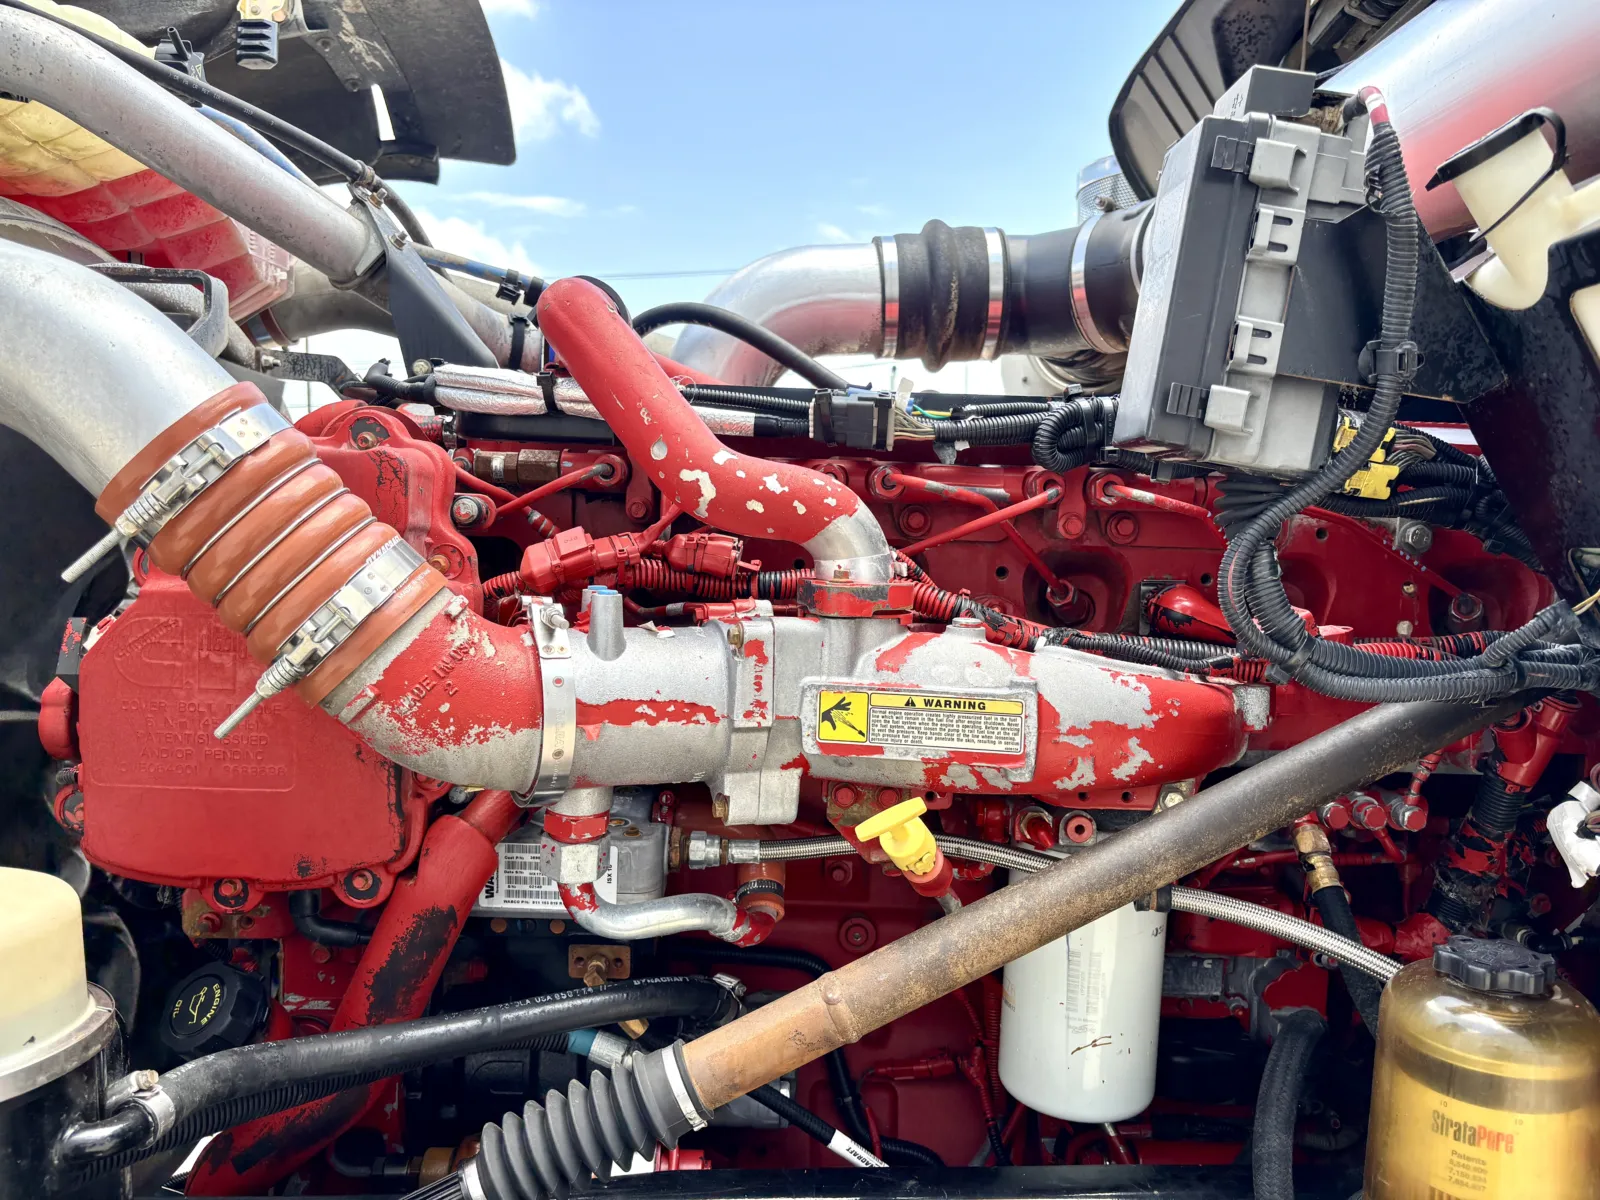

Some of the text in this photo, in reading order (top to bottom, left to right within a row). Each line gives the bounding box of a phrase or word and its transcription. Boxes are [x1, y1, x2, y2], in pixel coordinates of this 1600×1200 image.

[393, 674, 437, 718] MADE
[431, 657, 454, 681] IN
[441, 679, 460, 698] 2
[178, 701, 215, 713] BOLT
[924, 698, 986, 710] WARNING
[172, 999, 183, 1019] OIL
[200, 983, 220, 1025] ENGINE
